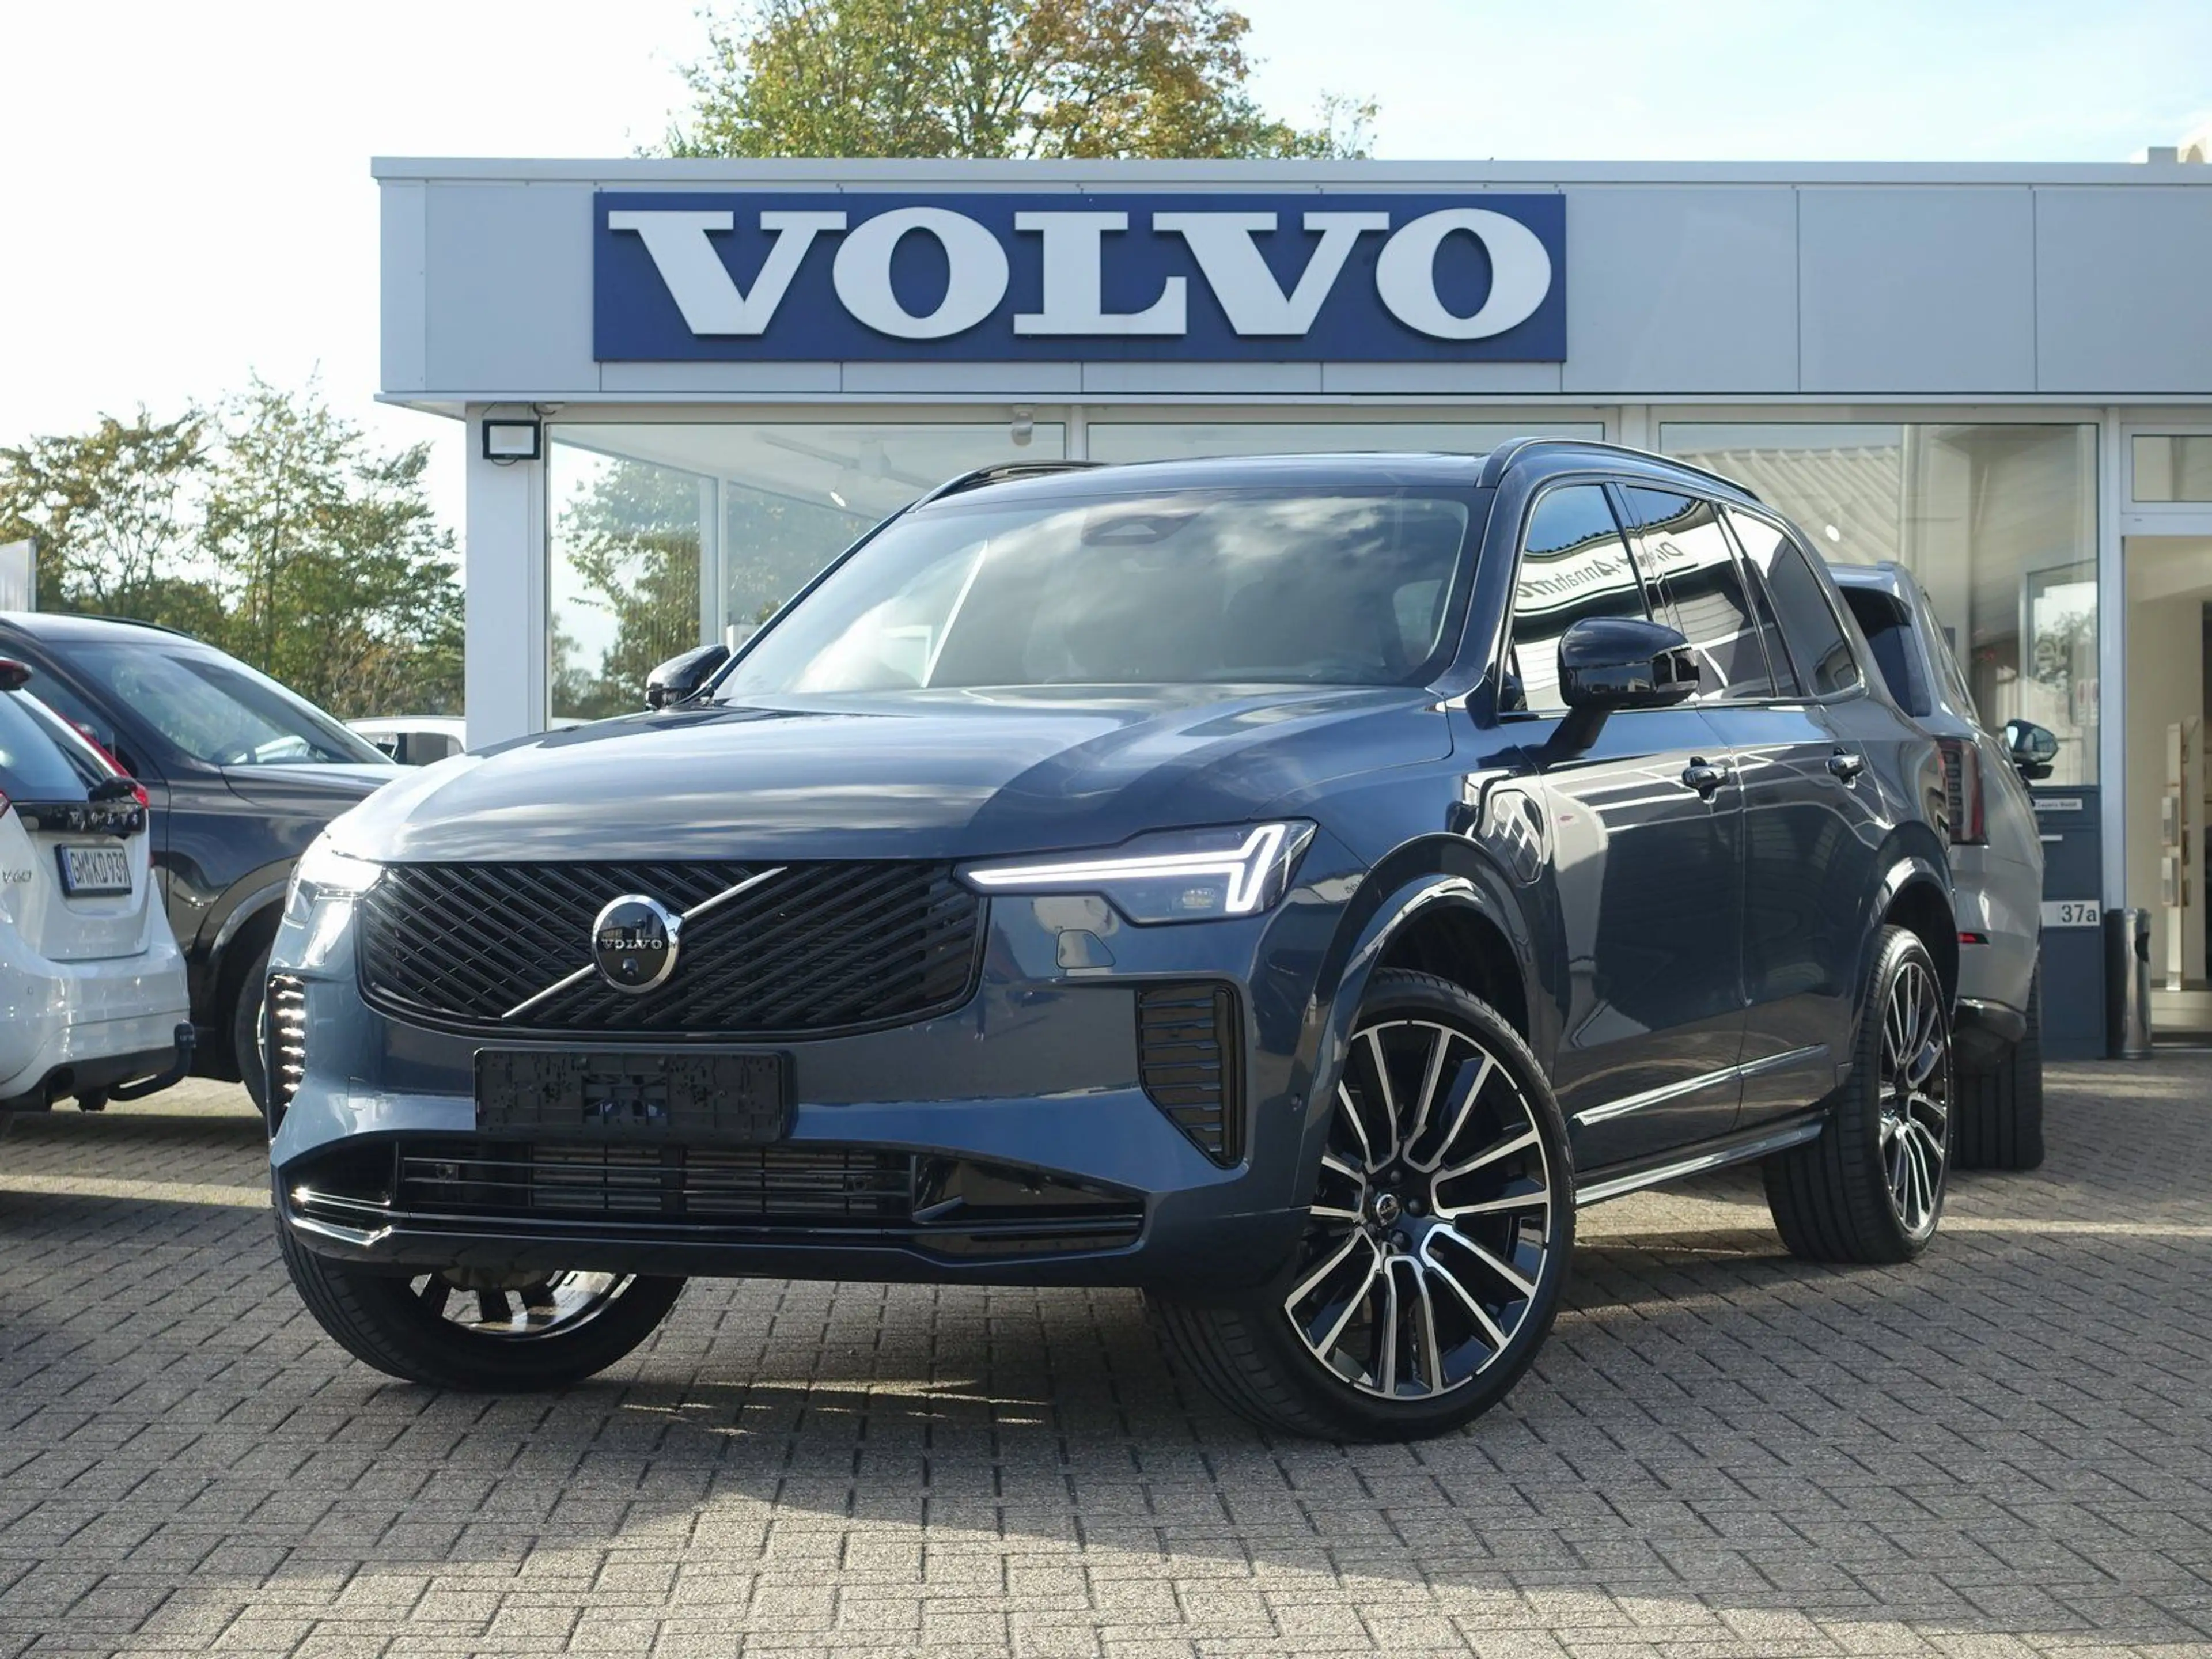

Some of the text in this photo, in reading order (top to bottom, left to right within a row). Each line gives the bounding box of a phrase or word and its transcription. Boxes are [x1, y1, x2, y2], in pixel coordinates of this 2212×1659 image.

[608, 206, 1552, 339] VOLVO
[2, 869, 32, 884] V60
[2061, 904, 2097, 923] 37a
[601, 938, 663, 950] VOLVO
